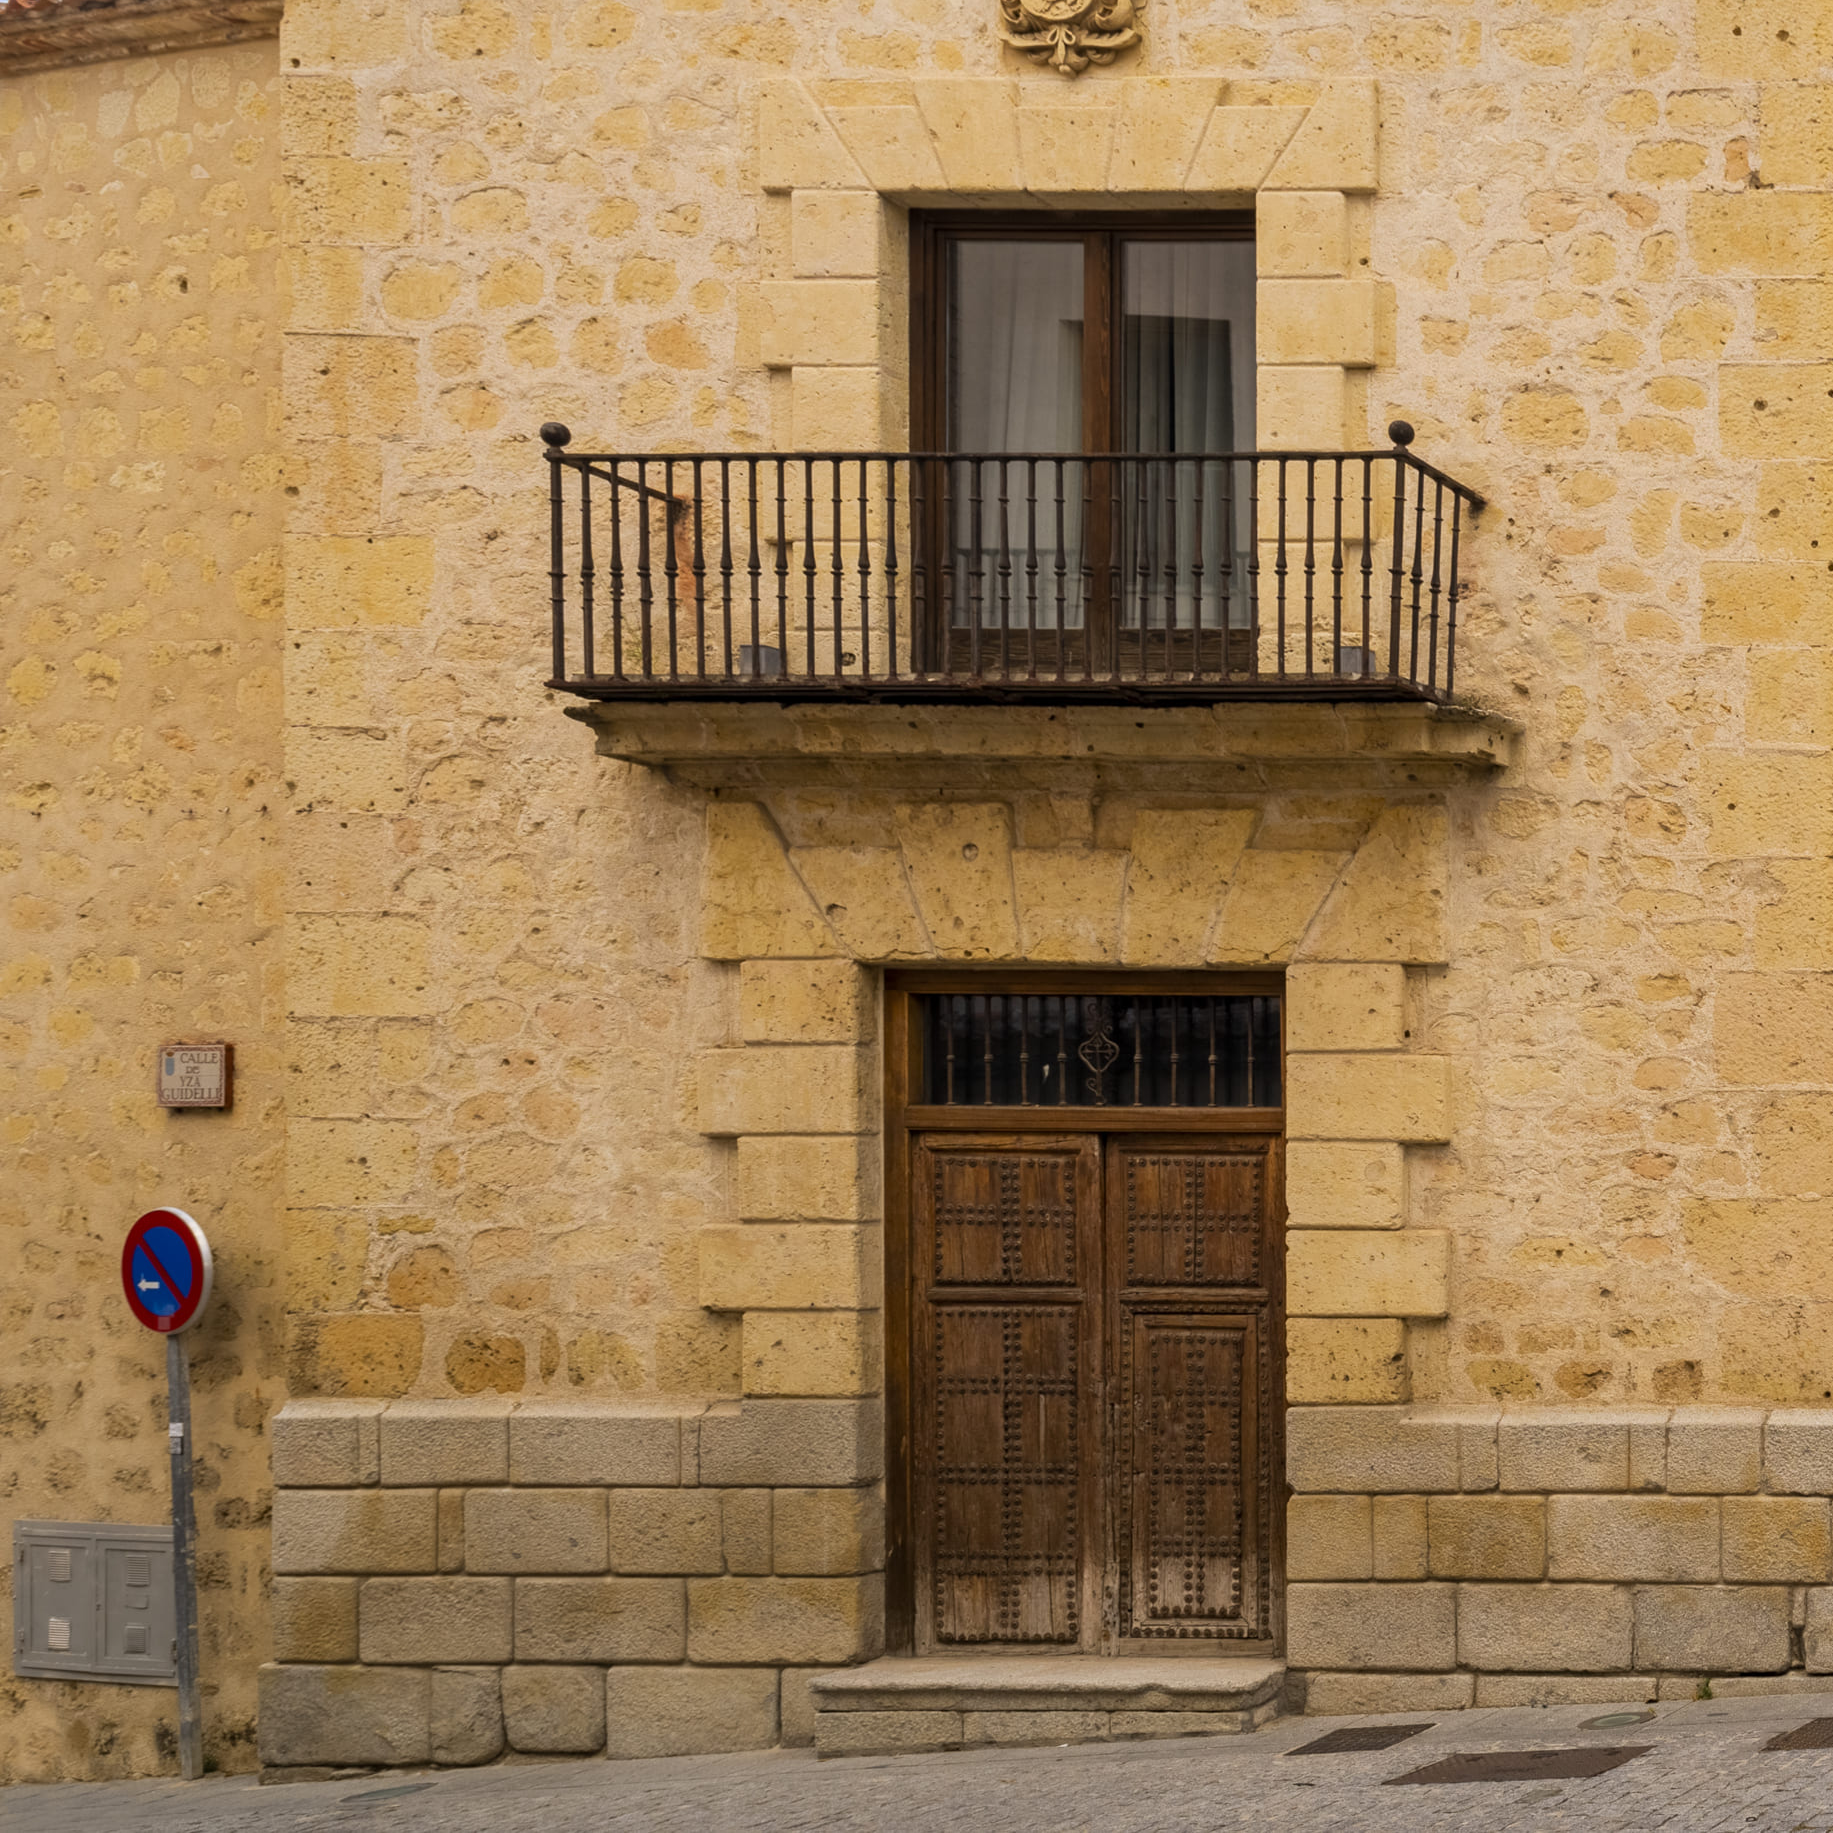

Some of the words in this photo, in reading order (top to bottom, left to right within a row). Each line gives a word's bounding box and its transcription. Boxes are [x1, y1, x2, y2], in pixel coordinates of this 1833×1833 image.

[180, 1053, 218, 1064] CALLE
[185, 1066, 200, 1074] DE
[180, 1076, 200, 1087] YZA
